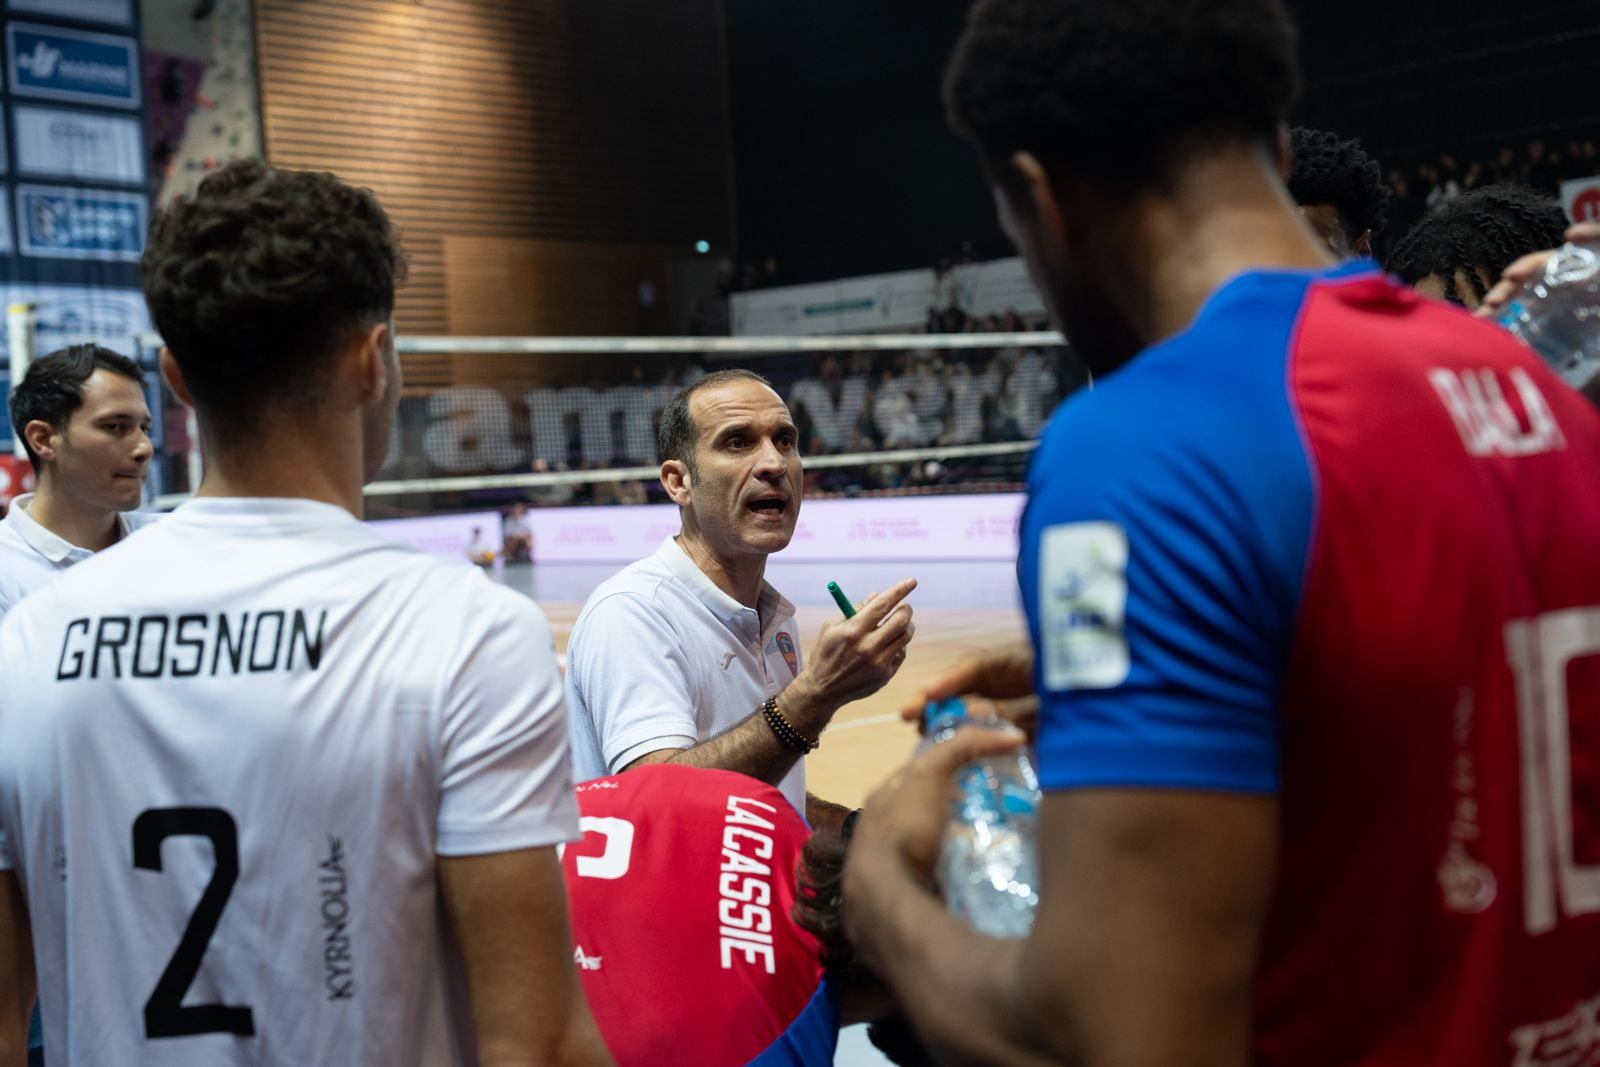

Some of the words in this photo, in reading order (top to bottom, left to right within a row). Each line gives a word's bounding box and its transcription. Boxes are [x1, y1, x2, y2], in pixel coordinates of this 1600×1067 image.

[56, 608, 328, 681] GROSNON
[132, 806, 255, 1039] 2
[318, 849, 354, 1002] KYRNOLIA
[719, 795, 777, 975] LACASSIE
